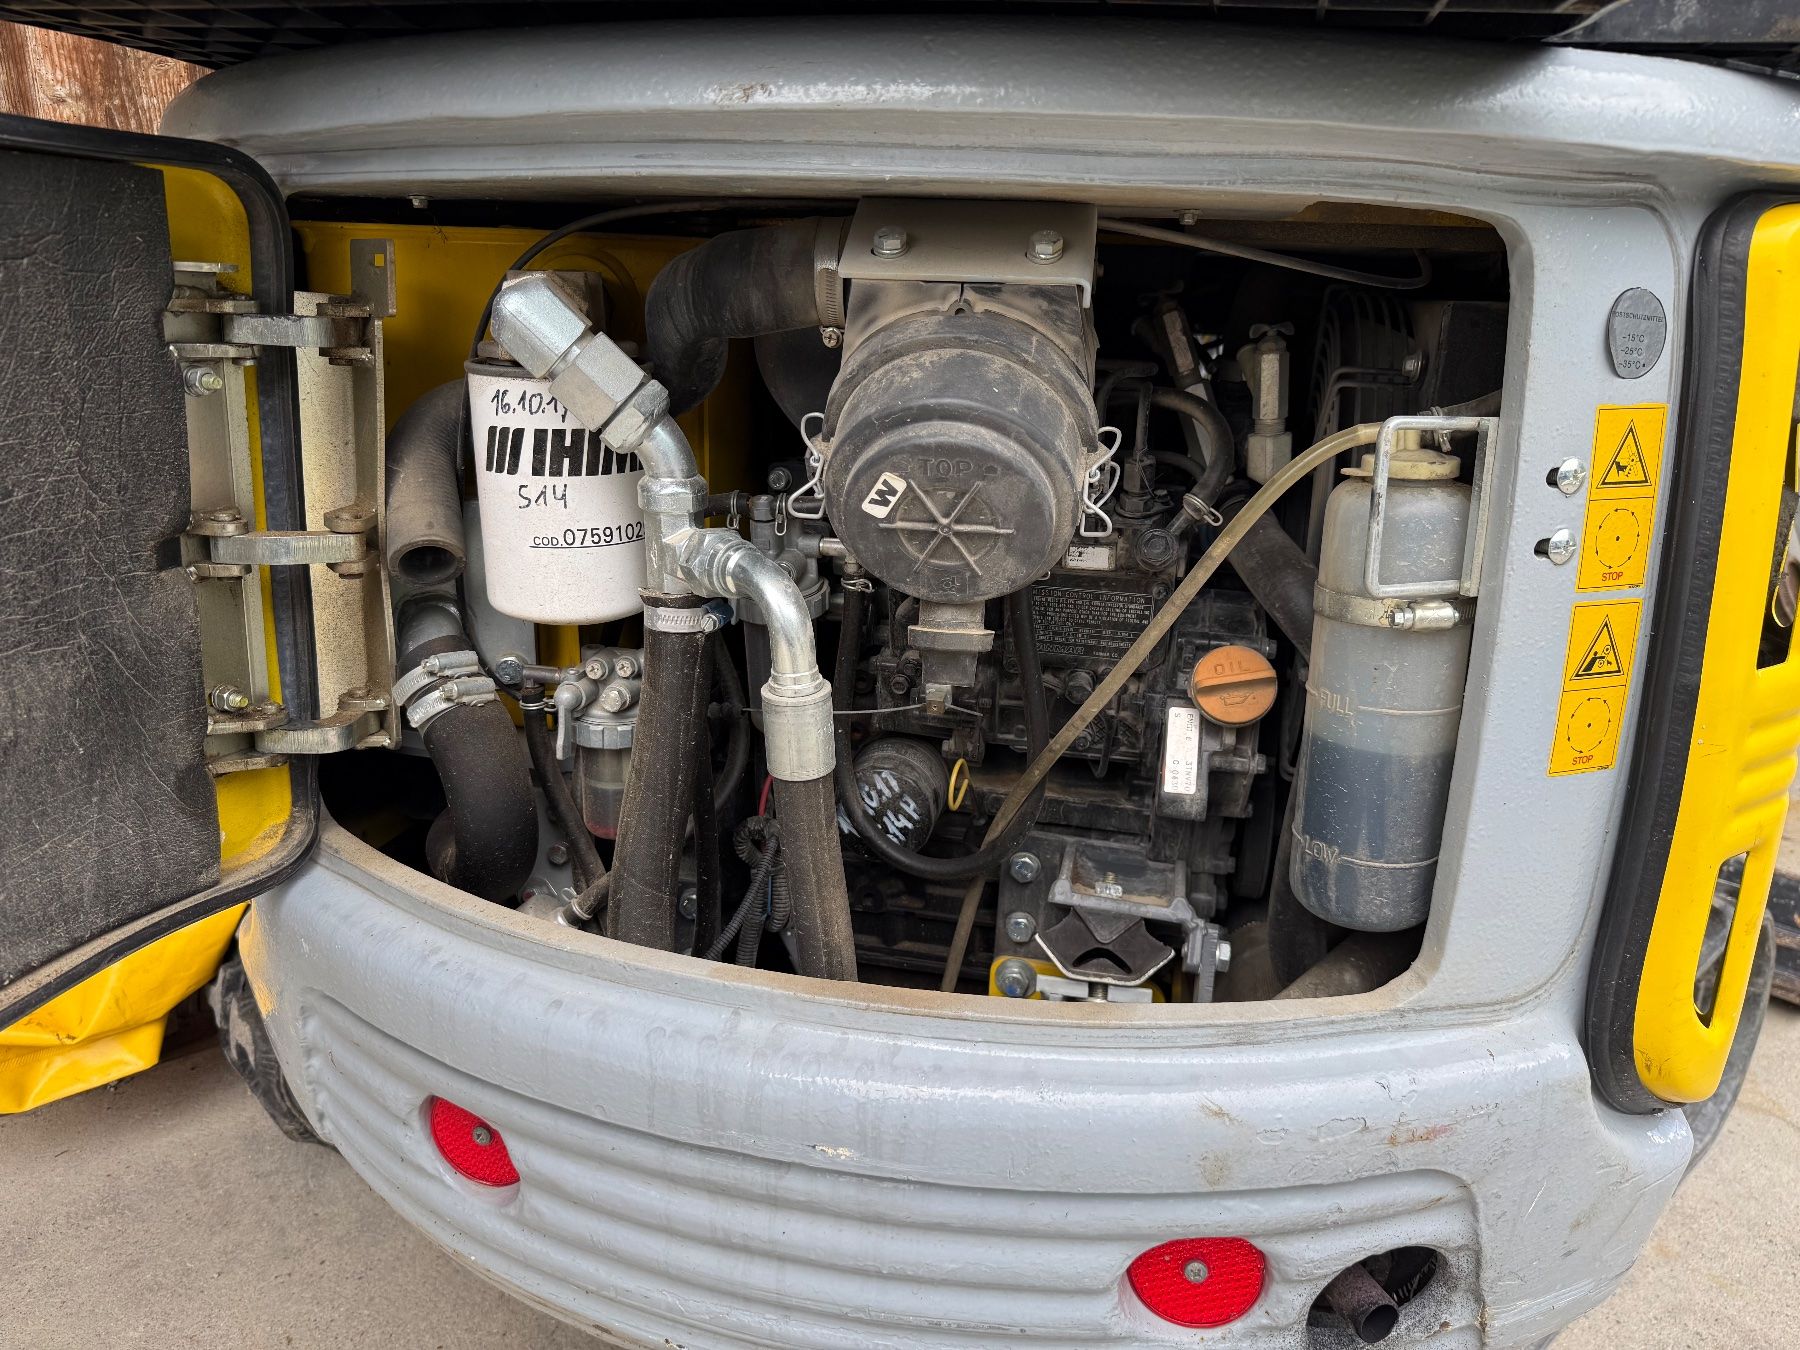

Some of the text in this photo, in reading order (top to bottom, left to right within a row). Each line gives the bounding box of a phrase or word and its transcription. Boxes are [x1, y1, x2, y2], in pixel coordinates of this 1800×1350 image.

[918, 457, 974, 478] TOP
[867, 478, 900, 508] W
[1601, 571, 1625, 582] STOP
[1214, 659, 1249, 676] OIL
[1319, 688, 1354, 717] FULL
[1571, 754, 1594, 765] STOP
[1304, 834, 1338, 863] LOW
